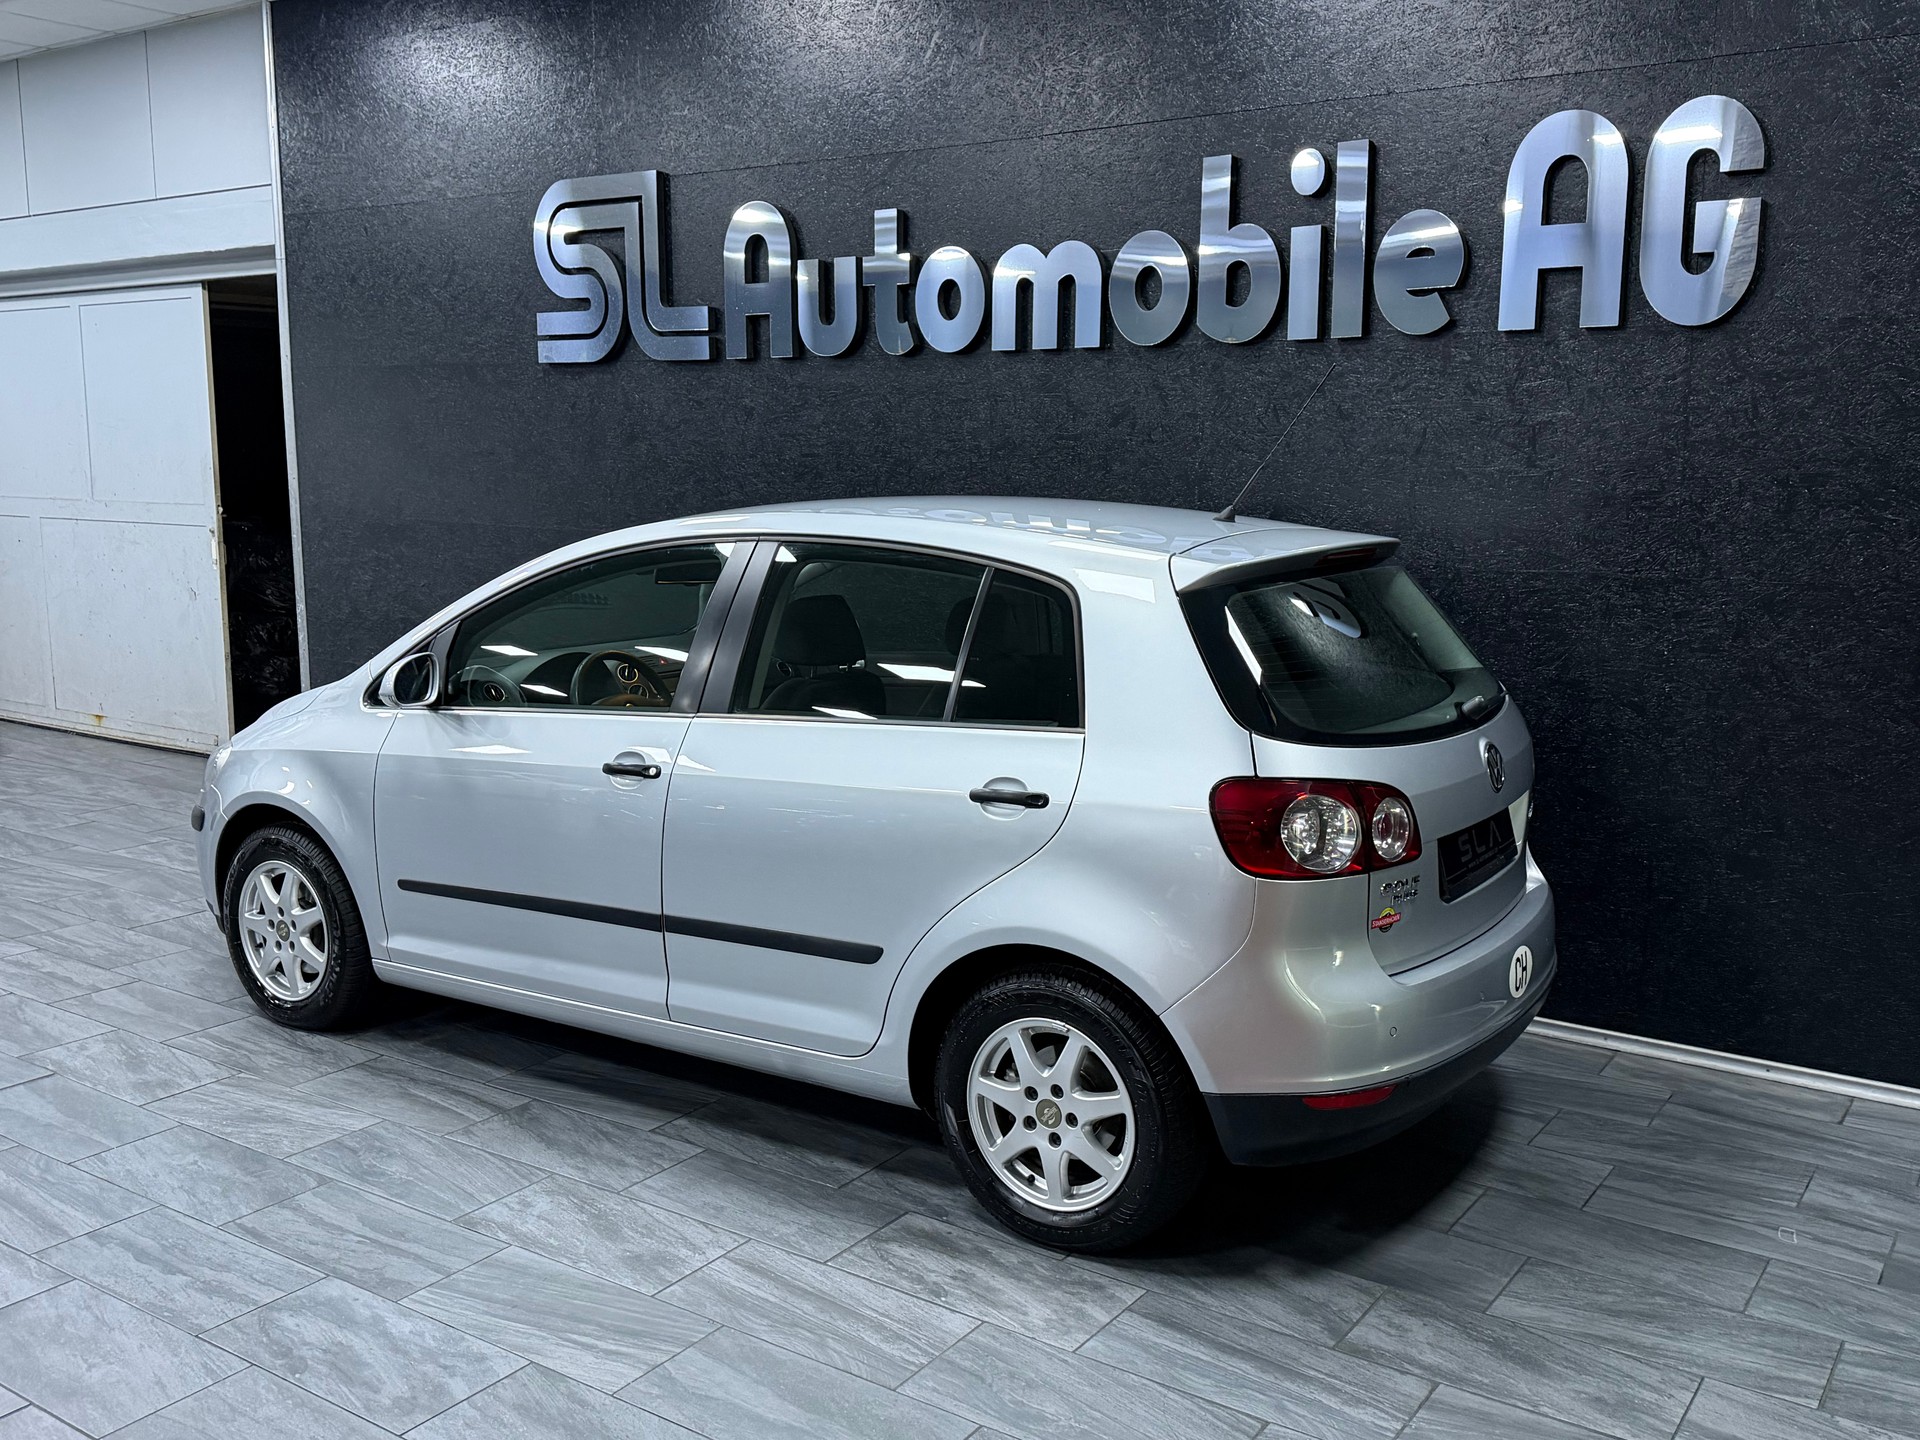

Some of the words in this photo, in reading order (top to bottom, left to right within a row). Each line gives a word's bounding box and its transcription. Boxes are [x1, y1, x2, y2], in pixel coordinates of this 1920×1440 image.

[534, 170, 710, 363] SL
[724, 139, 1466, 360] Automobile
[1498, 95, 1765, 331] AG
[1458, 820, 1502, 863] SLA
[1515, 950, 1527, 992] CH
